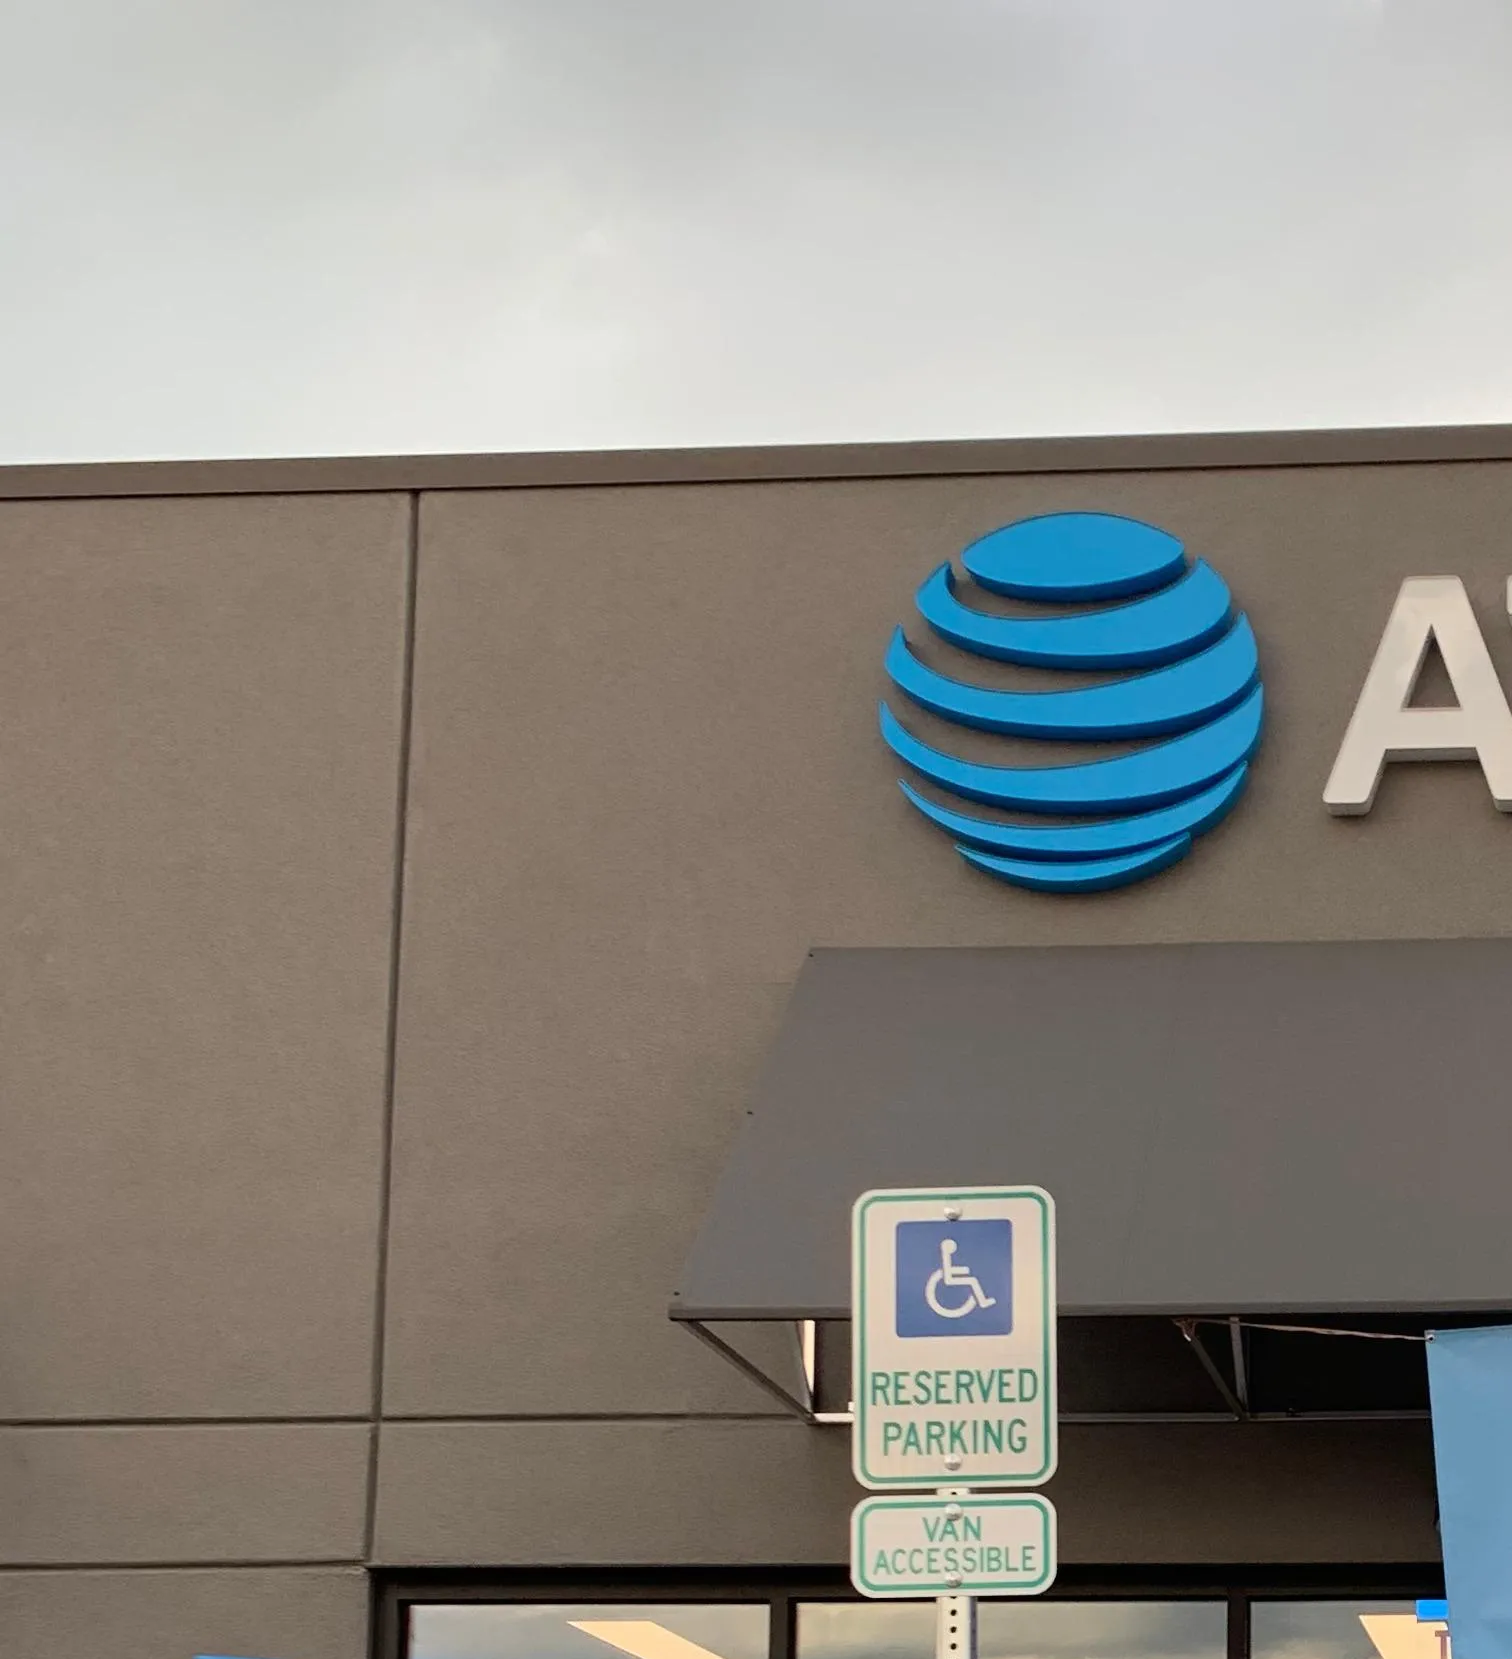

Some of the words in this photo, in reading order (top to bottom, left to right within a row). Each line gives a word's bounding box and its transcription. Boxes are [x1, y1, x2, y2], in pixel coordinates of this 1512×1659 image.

[871, 1368, 1038, 1406] RESERVED
[883, 1418, 1028, 1456] PARKING
[922, 1515, 982, 1542] VAN
[873, 1545, 1036, 1575] ACCESSIBLE
